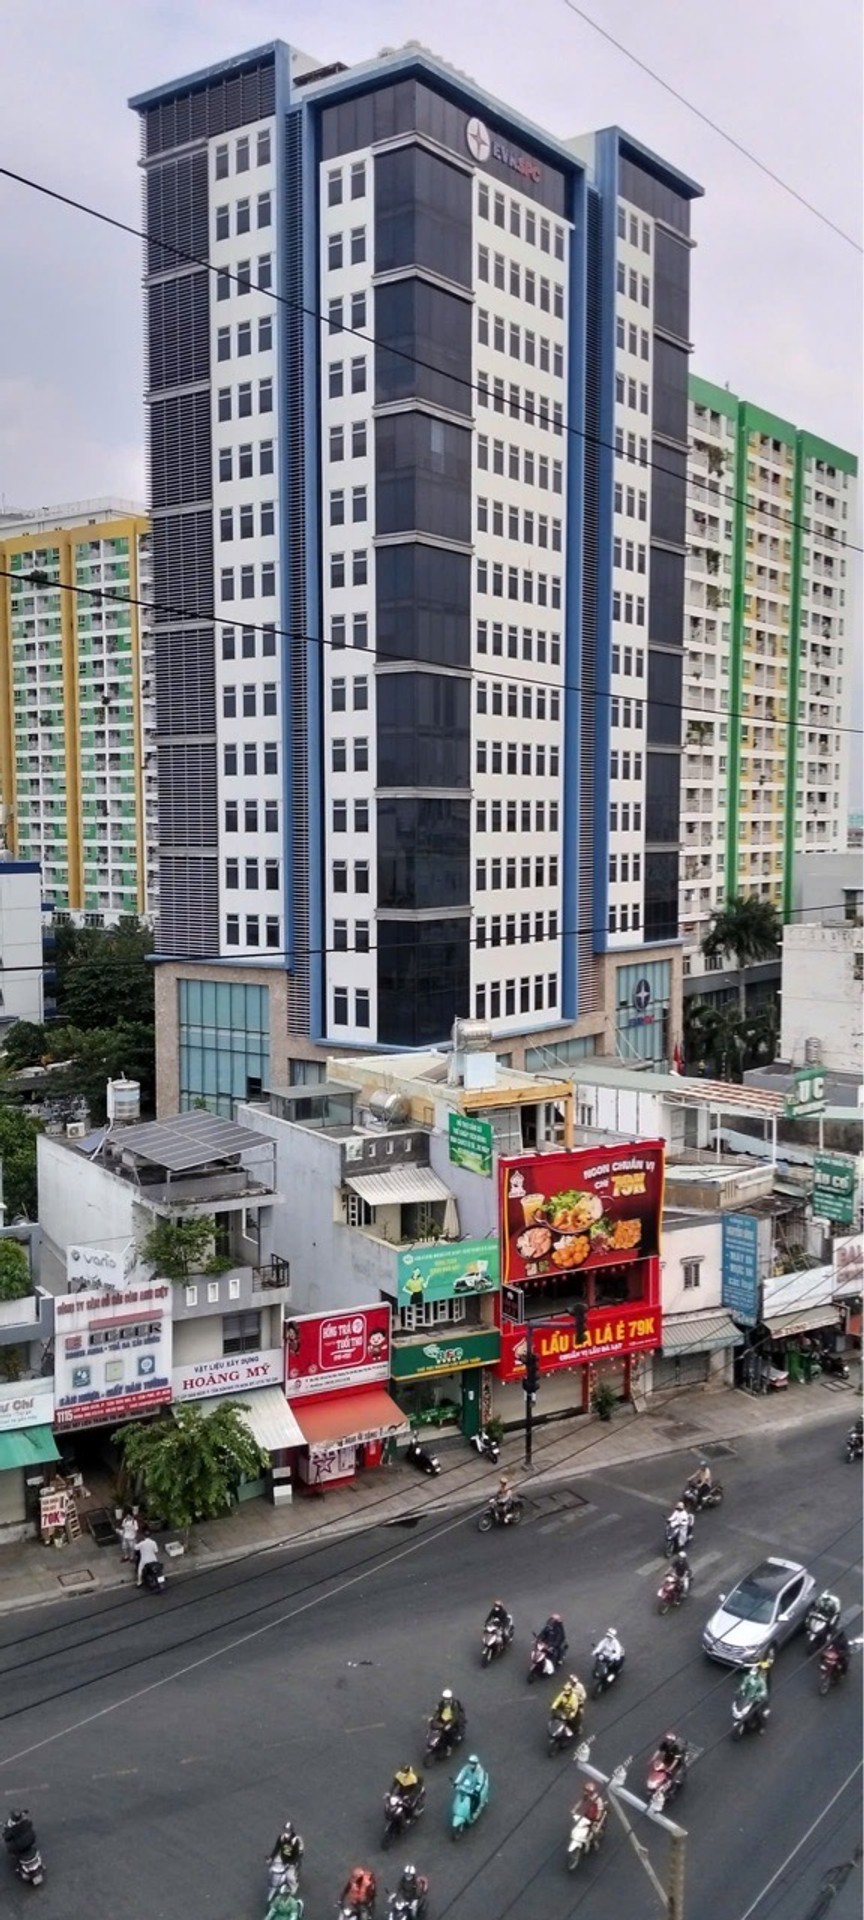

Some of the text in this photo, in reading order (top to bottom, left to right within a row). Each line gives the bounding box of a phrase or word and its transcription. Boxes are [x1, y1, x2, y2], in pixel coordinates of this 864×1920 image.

[584, 1164, 610, 1180] NGON
[541, 1330, 570, 1356] LẨU
[595, 1322, 614, 1344] LÁ
[628, 1316, 656, 1339] 79K
[194, 1355, 259, 1373] VẬT LIỆU XÂY DỰNG
[182, 1371, 240, 1390] HOÀNG
[246, 1361, 270, 1378] MỸ
[42, 1511, 61, 1526] 70K
